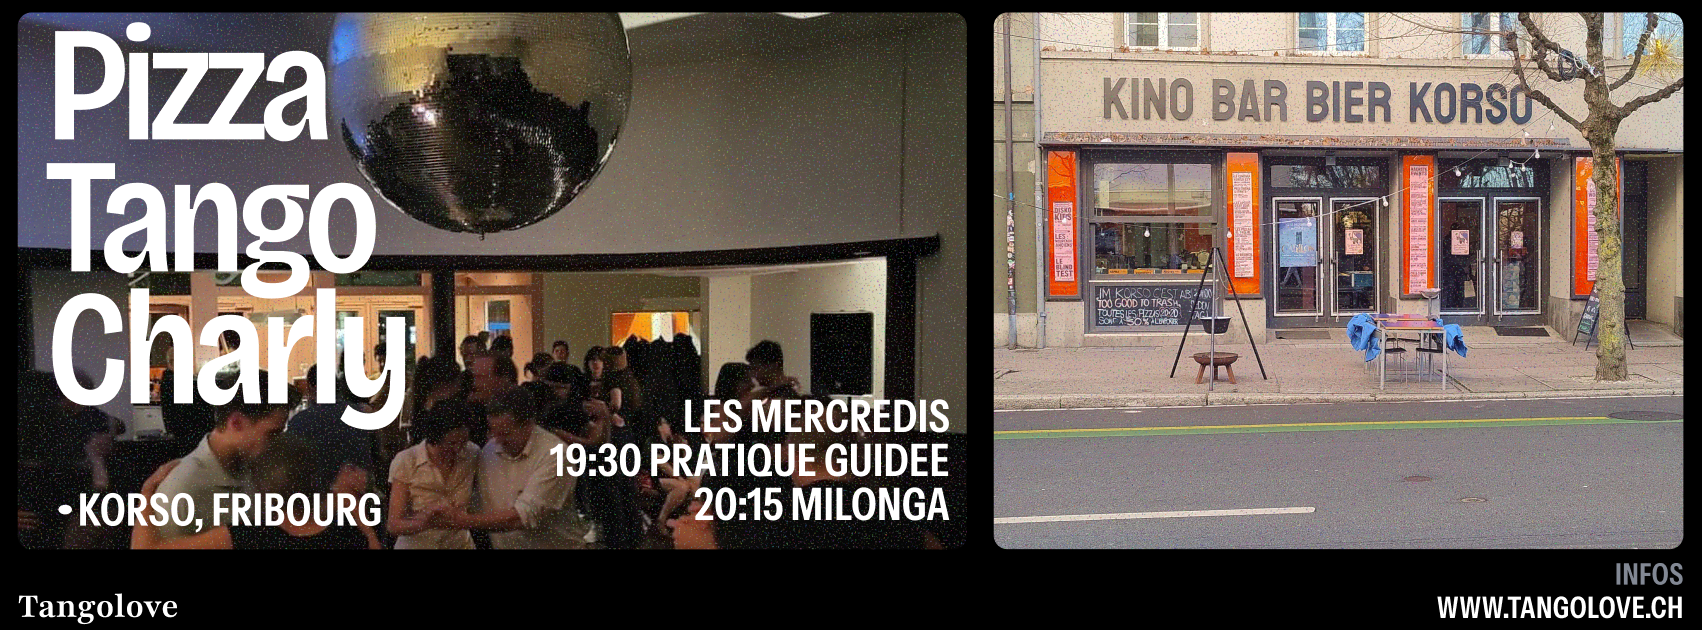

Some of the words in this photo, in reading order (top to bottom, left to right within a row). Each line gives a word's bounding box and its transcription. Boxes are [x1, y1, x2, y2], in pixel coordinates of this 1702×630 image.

[1103, 77, 1194, 121] KINO
[1212, 78, 1288, 122] BAR
[1306, 80, 1391, 123] BIER
[1409, 81, 1532, 125] KORSO
[1115, 287, 1151, 299] KORSO
[1097, 299, 1113, 308] TOO
[1114, 298, 1138, 308] GOOD
[1140, 299, 1149, 307] TO
[1097, 308, 1124, 318] TOUTES
